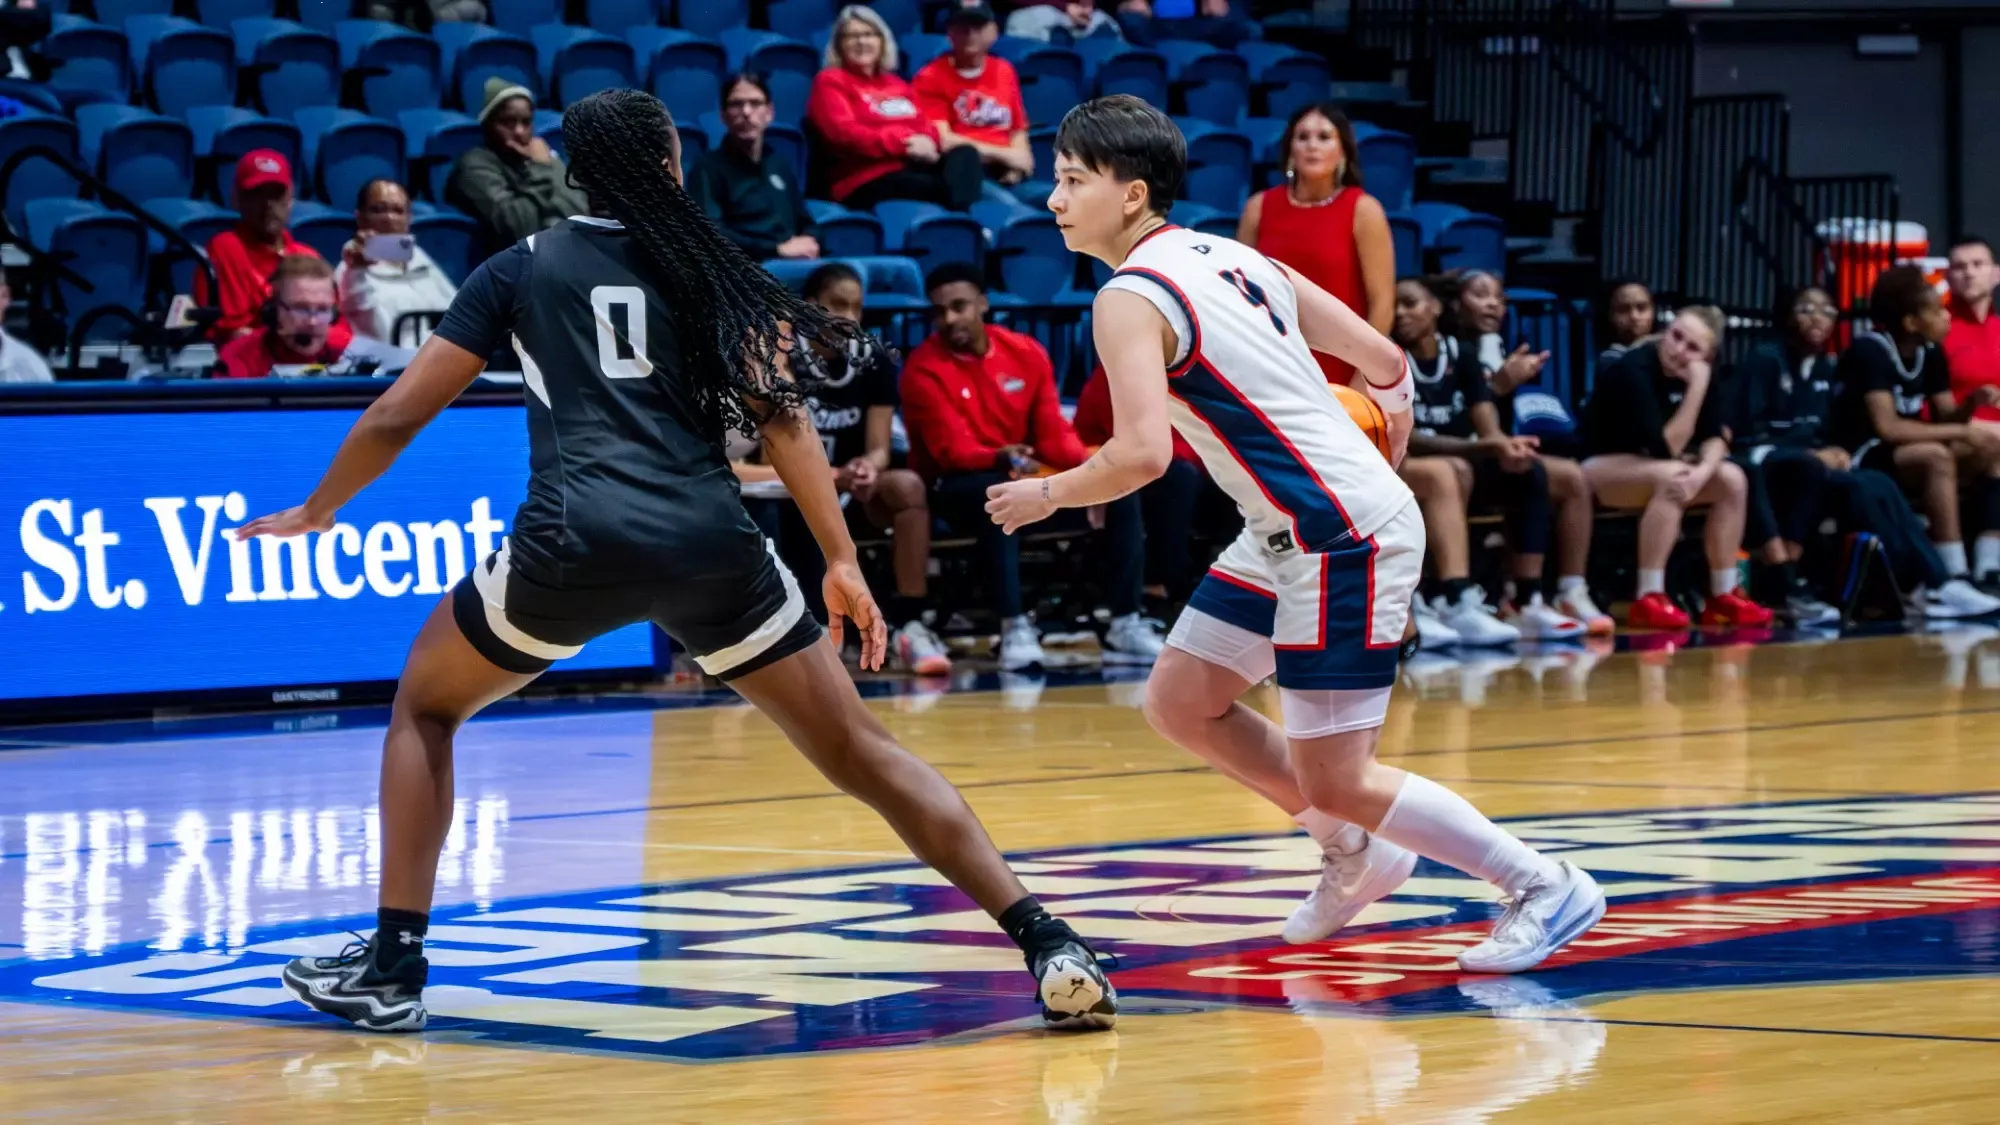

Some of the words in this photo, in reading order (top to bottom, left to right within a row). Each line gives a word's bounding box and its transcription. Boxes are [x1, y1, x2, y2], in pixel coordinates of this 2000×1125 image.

[590, 285, 653, 378] 0
[20, 499, 146, 613] St.
[144, 493, 505, 604] Vincent
[33, 796, 2000, 1006] SOUTHER
